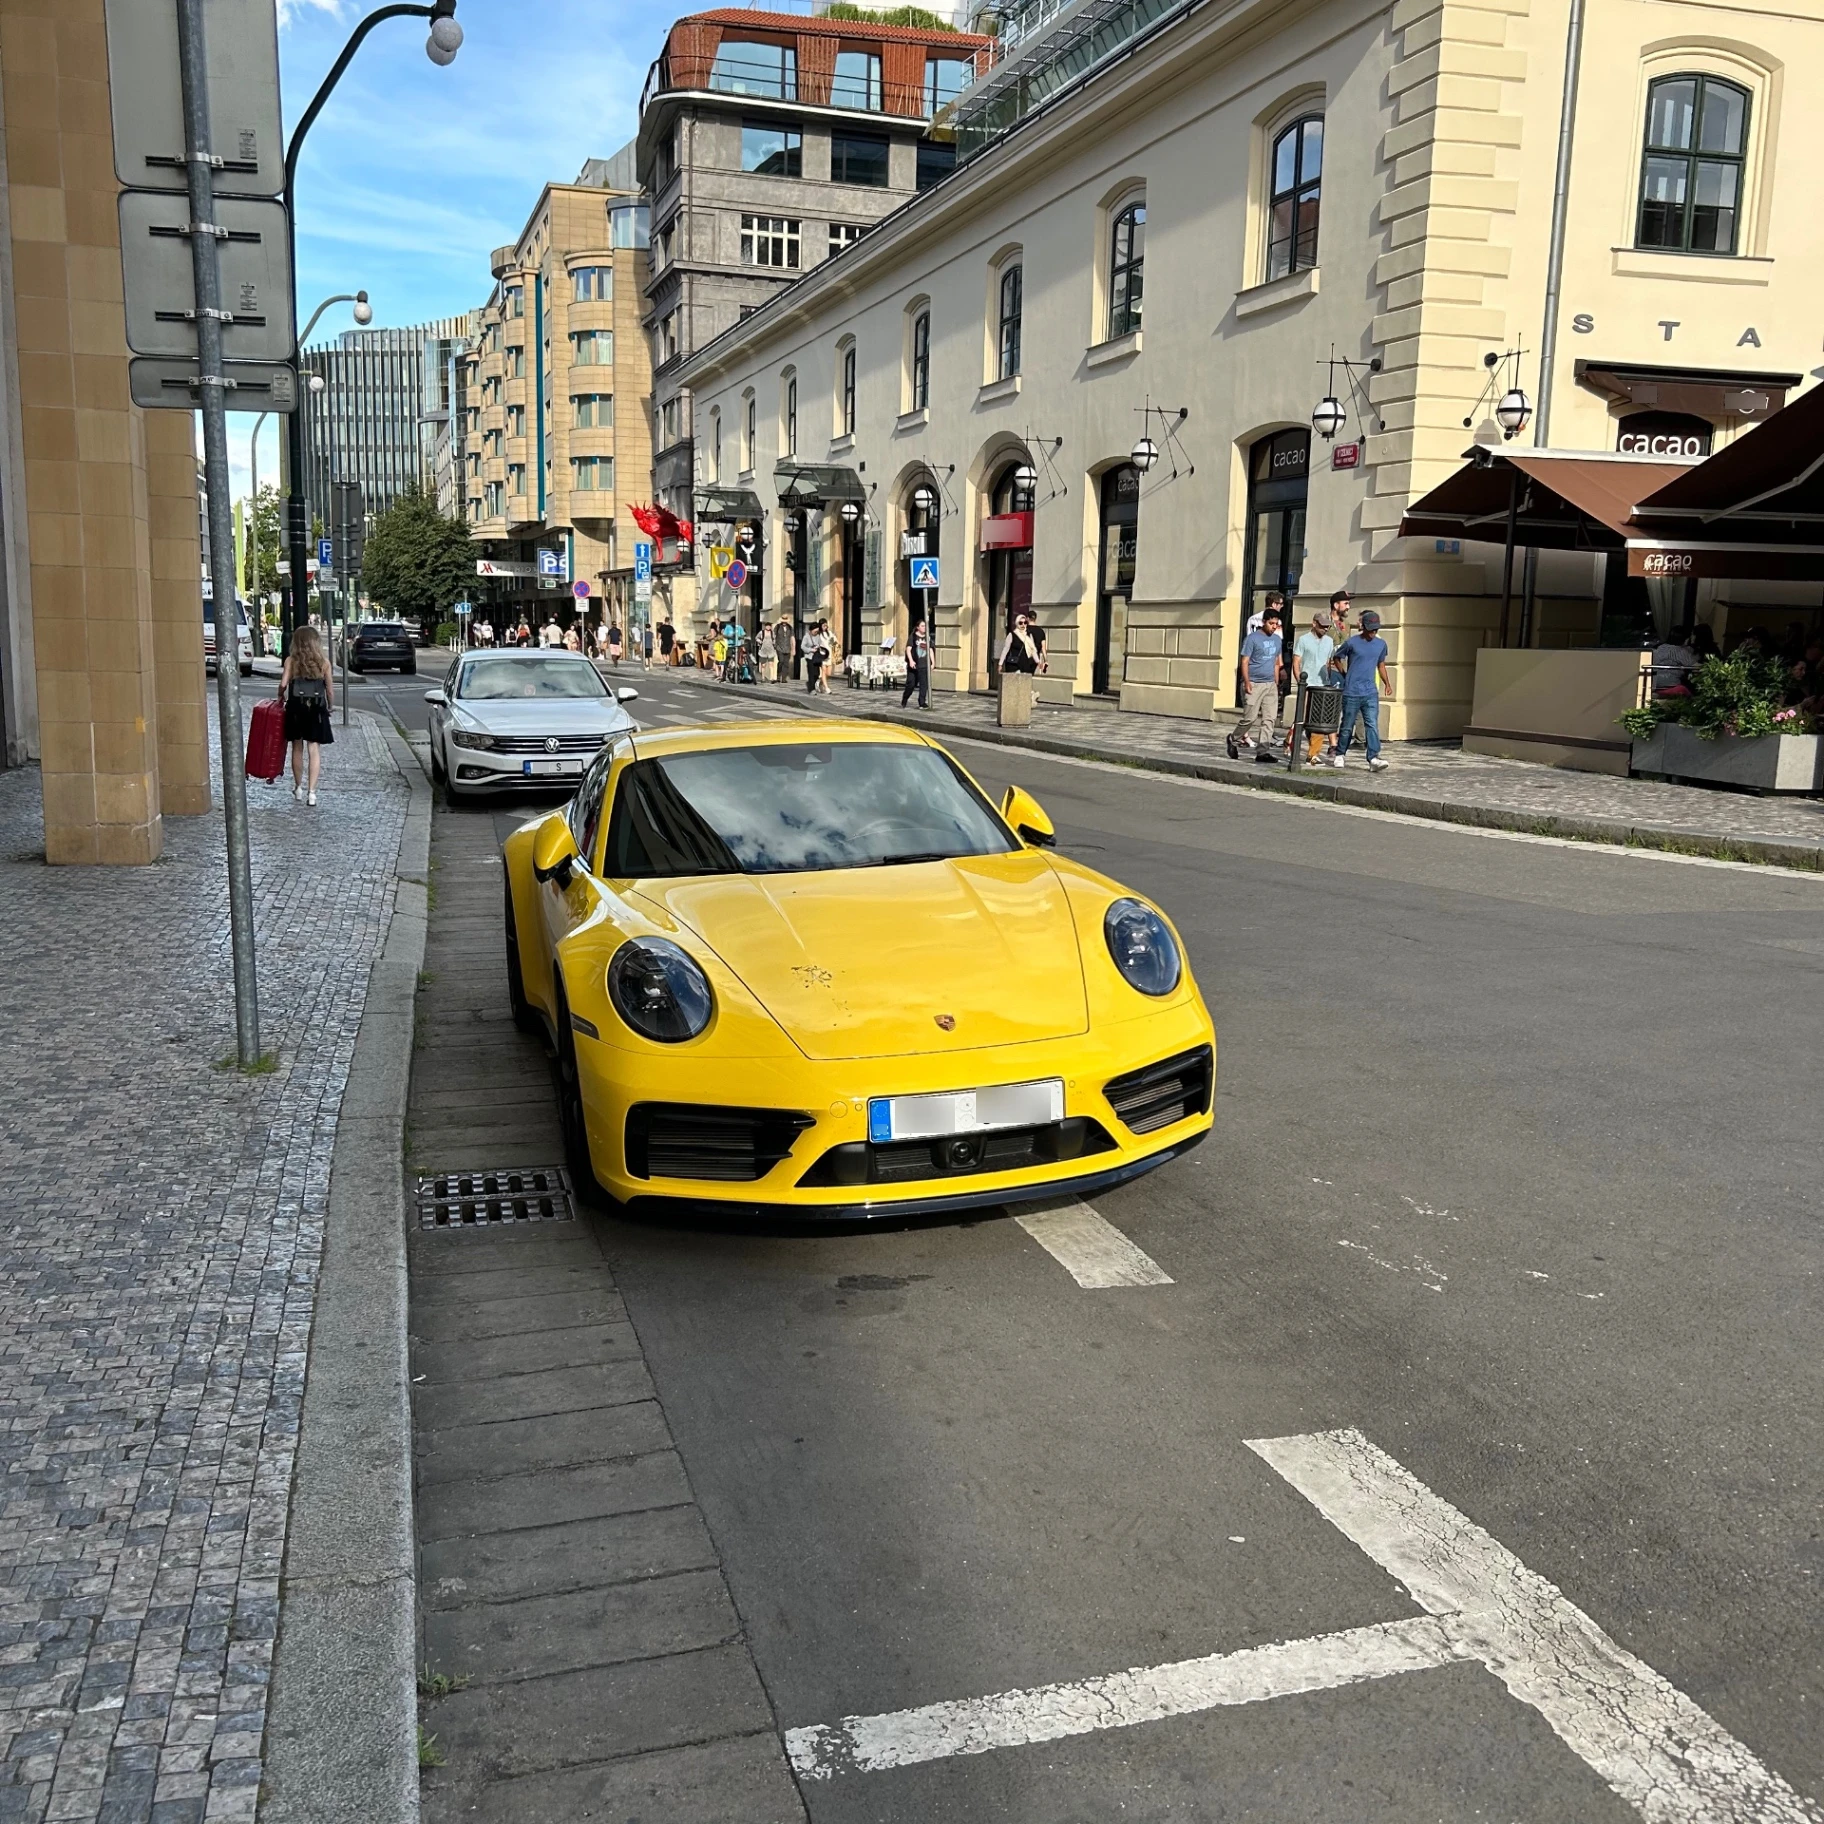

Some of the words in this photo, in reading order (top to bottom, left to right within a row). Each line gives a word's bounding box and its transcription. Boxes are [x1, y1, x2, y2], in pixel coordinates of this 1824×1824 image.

[1620, 433, 1700, 456] cacao
[1273, 449, 1306, 467] cacao
[1112, 539, 1137, 559] caca
[1645, 554, 1692, 568] cacao
